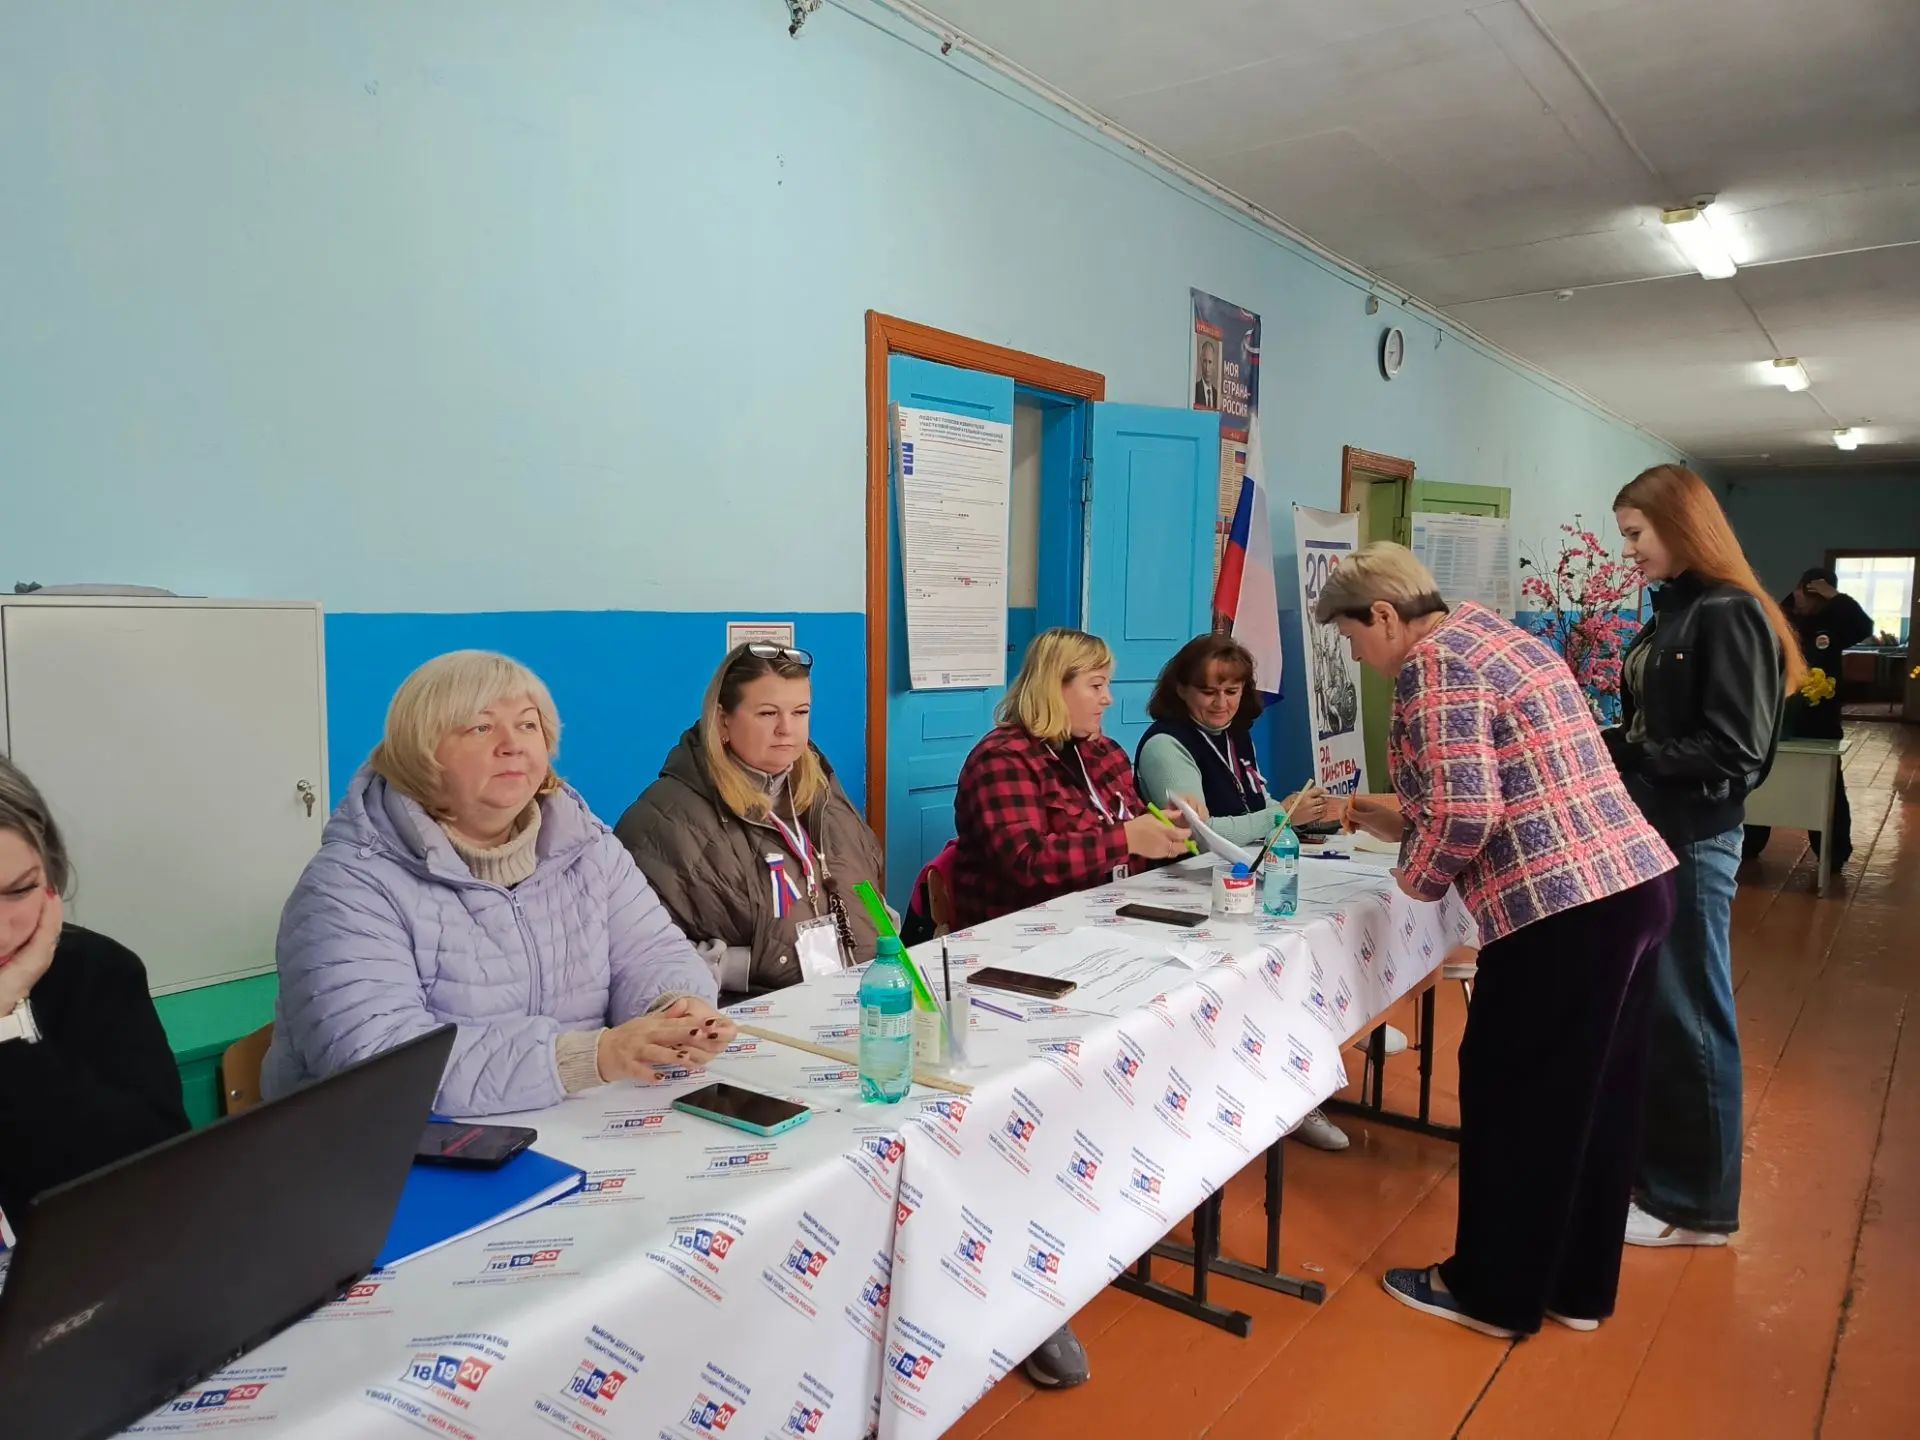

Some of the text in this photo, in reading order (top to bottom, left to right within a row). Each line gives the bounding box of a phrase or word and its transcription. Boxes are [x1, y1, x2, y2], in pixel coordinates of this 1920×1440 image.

[1224, 360, 1238, 378] МОЯ
[1222, 399, 1248, 417] РОССИЯ
[1320, 746, 1330, 764] ОД
[952, 1104, 964, 1118] 20
[603, 1179, 622, 1188] 20
[678, 1233, 729, 1254] 18 19 20
[492, 1251, 556, 1270] 18 19 20
[646, 1252, 666, 1263] ТВОЙ
[666, 1260, 686, 1276] ГОЛОС
[787, 1254, 822, 1271] 18 19 20
[1046, 1257, 1058, 1271] 20
[350, 1286, 374, 1296] 20
[592, 1324, 645, 1362] ВЫБОРЫ ДЕПУТАТОВ
[706, 1360, 726, 1378] ВЫБОРЫ
[886, 1351, 928, 1374] 18 19 20
[412, 1362, 484, 1384] 18 19 20
[570, 1375, 620, 1394] 18 19 20
[172, 1386, 258, 1412] 18 19 20
[431, 1386, 470, 1410] СЕНТЯБРЯ
[580, 1398, 607, 1416] СЕНТЯБРЯ
[365, 1388, 392, 1403] ТВОЙ
[392, 1398, 421, 1417] ГОЛОС
[427, 1414, 446, 1430] СИЛА
[534, 1400, 550, 1413] ТВОЙ
[572, 1420, 588, 1434] СИЛА
[688, 1408, 730, 1425] 18 19 20
[789, 1412, 820, 1428] 18 19 20
